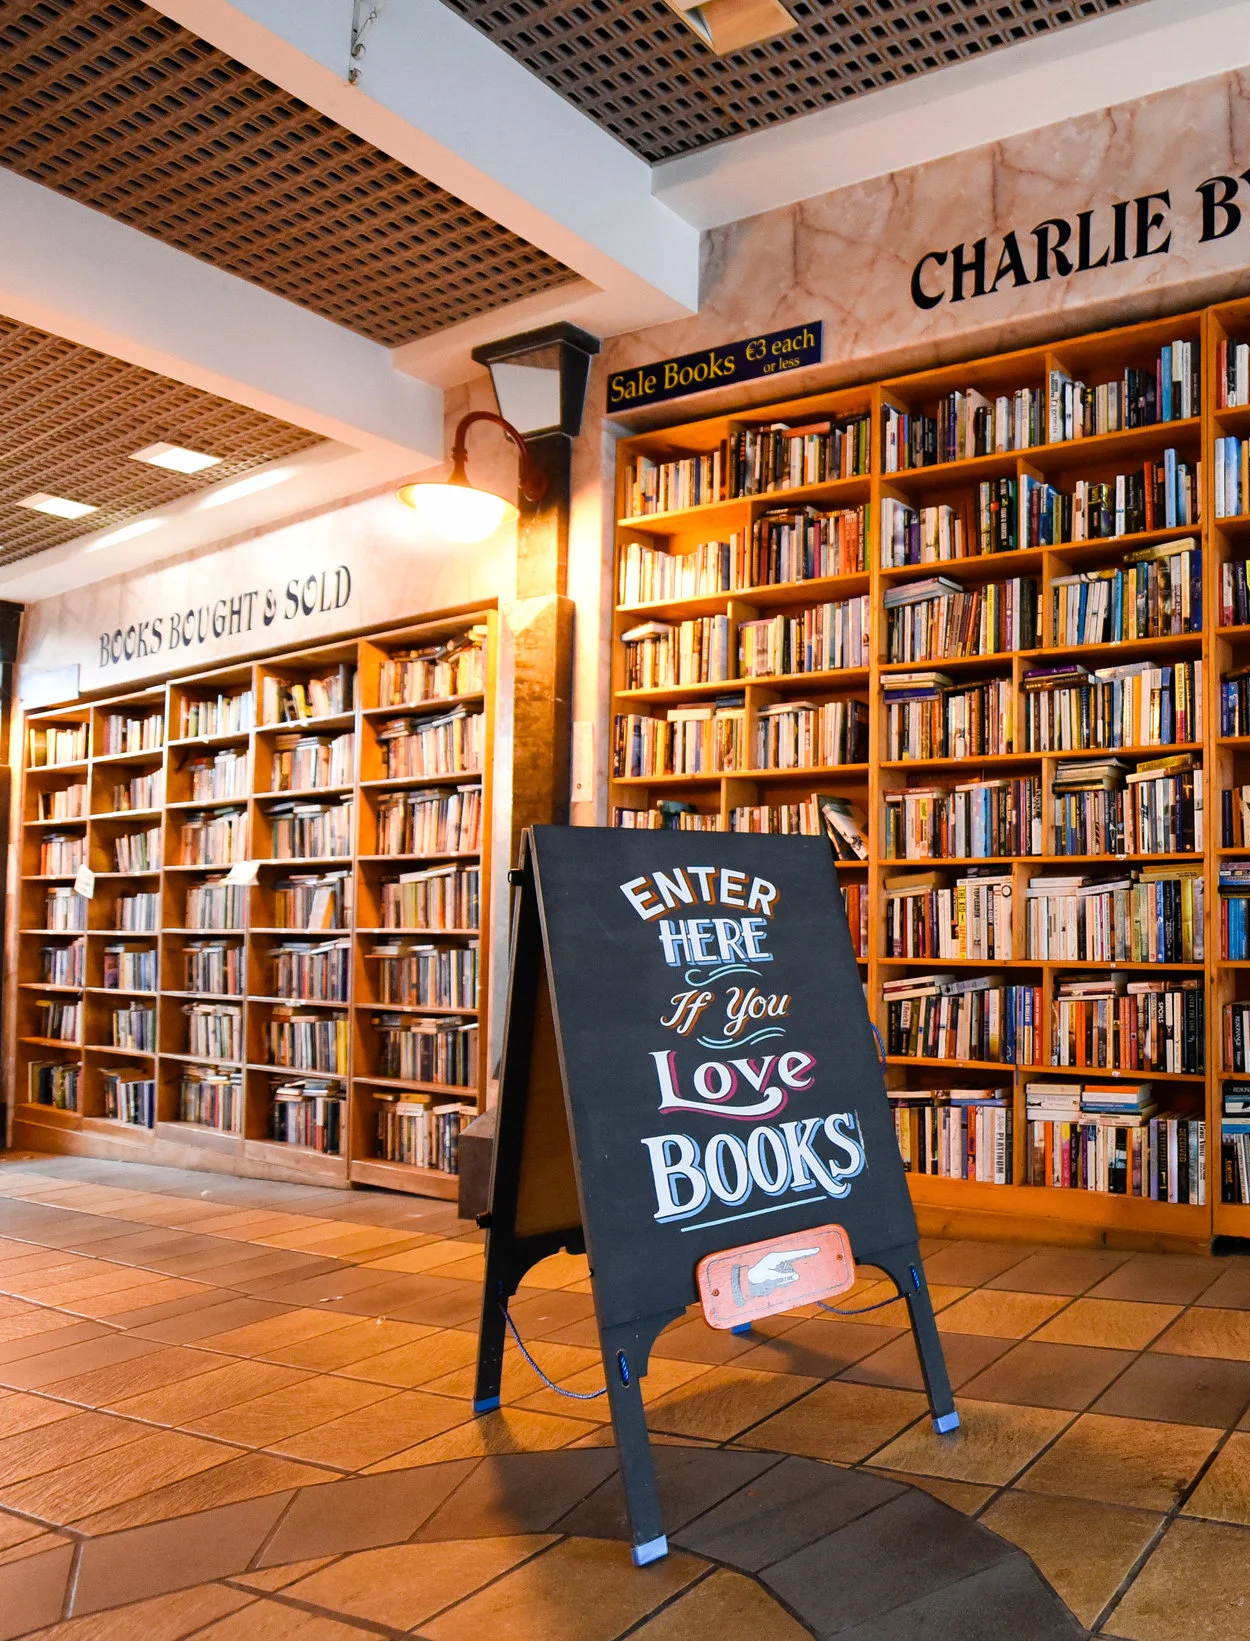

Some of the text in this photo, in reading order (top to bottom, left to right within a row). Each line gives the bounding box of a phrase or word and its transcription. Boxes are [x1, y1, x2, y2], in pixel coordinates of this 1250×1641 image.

[910, 190, 1172, 310] CHARLIE
[610, 328, 815, 403] Sale Books €3 each
[763, 354, 800, 375] or less
[99, 565, 352, 668] BOOKS BOUGHT & SOLD
[620, 866, 779, 922] ENTER
[659, 918, 774, 965] HERE
[661, 987, 791, 1036] If You
[902, 1006, 910, 1026] Reichs
[649, 1049, 816, 1120] Love
[641, 1112, 866, 1223] BOOKS
[996, 1133, 1004, 1174] PLATINUM
